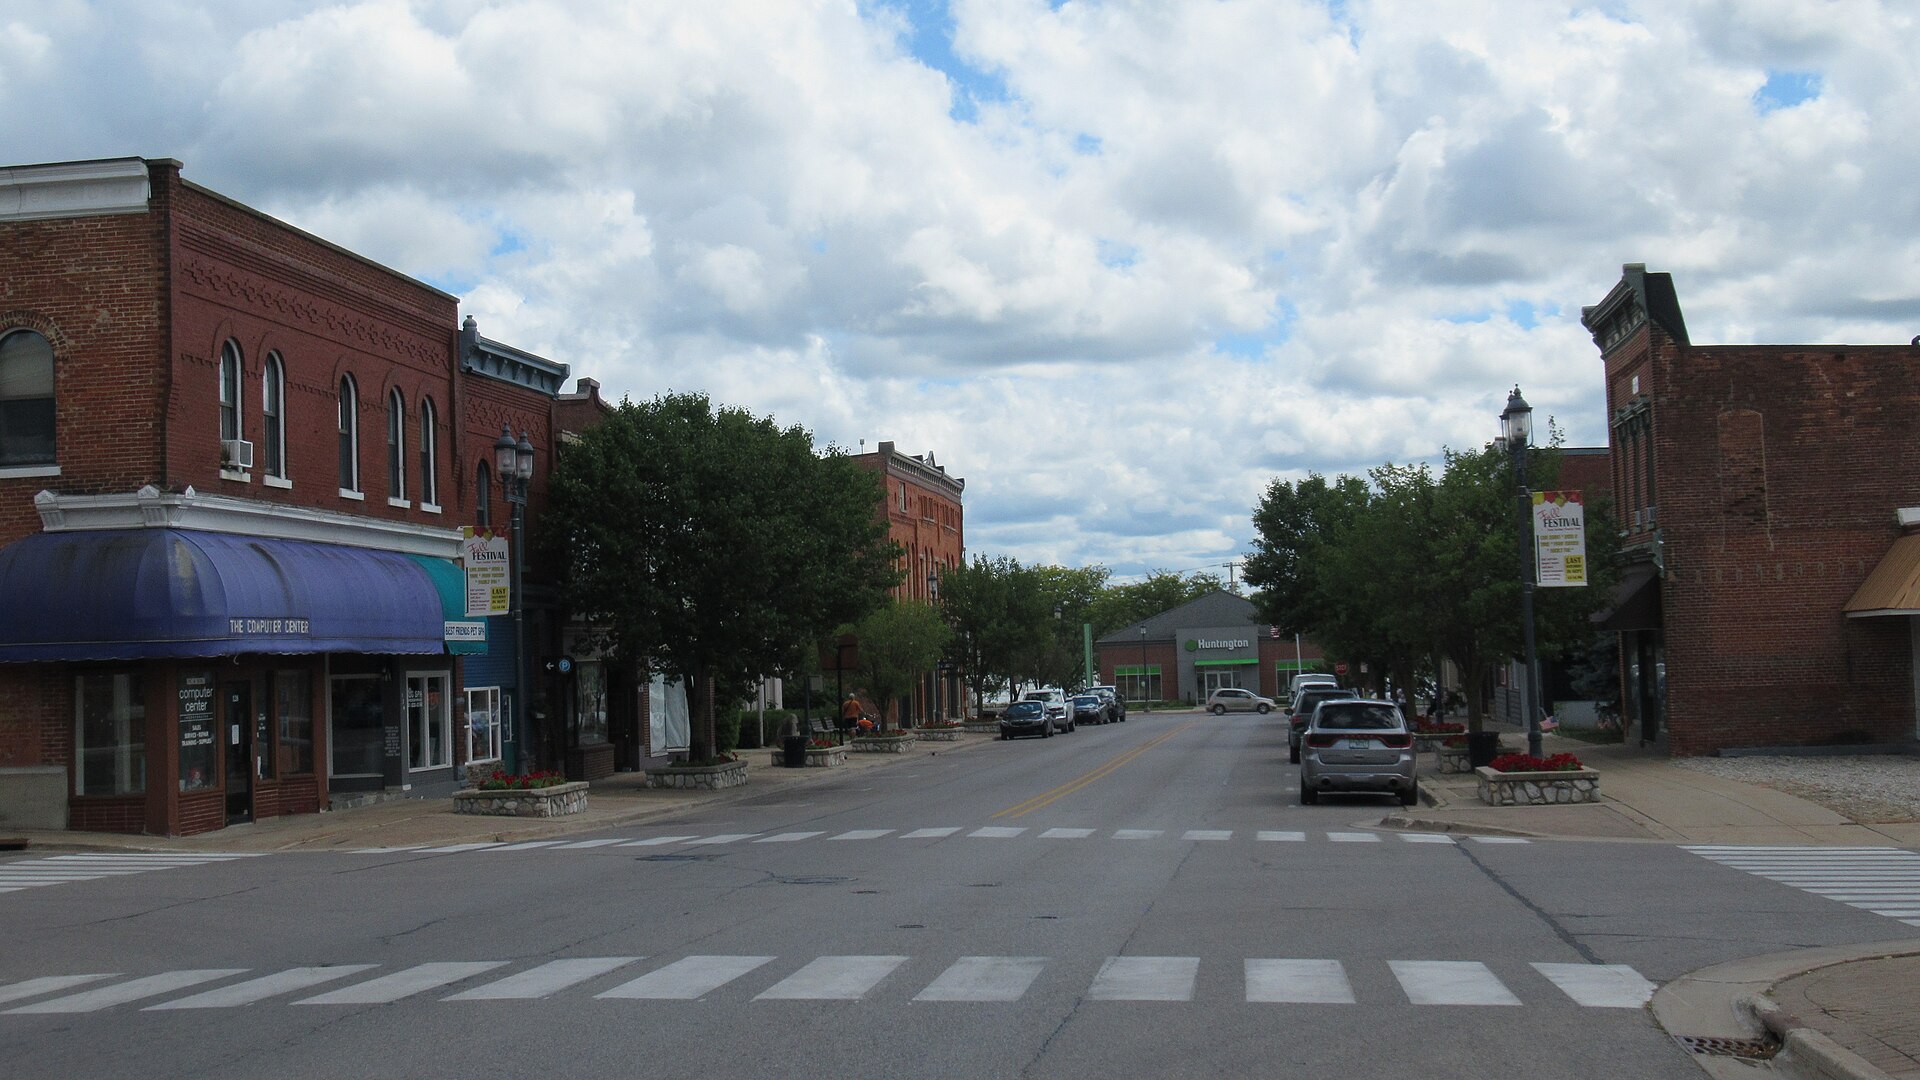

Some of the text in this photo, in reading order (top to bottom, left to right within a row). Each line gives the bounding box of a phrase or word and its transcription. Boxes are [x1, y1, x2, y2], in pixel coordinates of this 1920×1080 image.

[1543, 517, 1582, 528] FESTIVAL
[472, 551, 507, 561] FESTIVAL
[229, 619, 309, 634] THE COMPUTER CENTER
[445, 626, 455, 636] BEST
[455, 626, 470, 636] FRIENDS
[470, 626, 478, 636] PET
[1198, 639, 1249, 650] Huntington
[179, 687, 213, 700] computer
[185, 700, 208, 712] center
